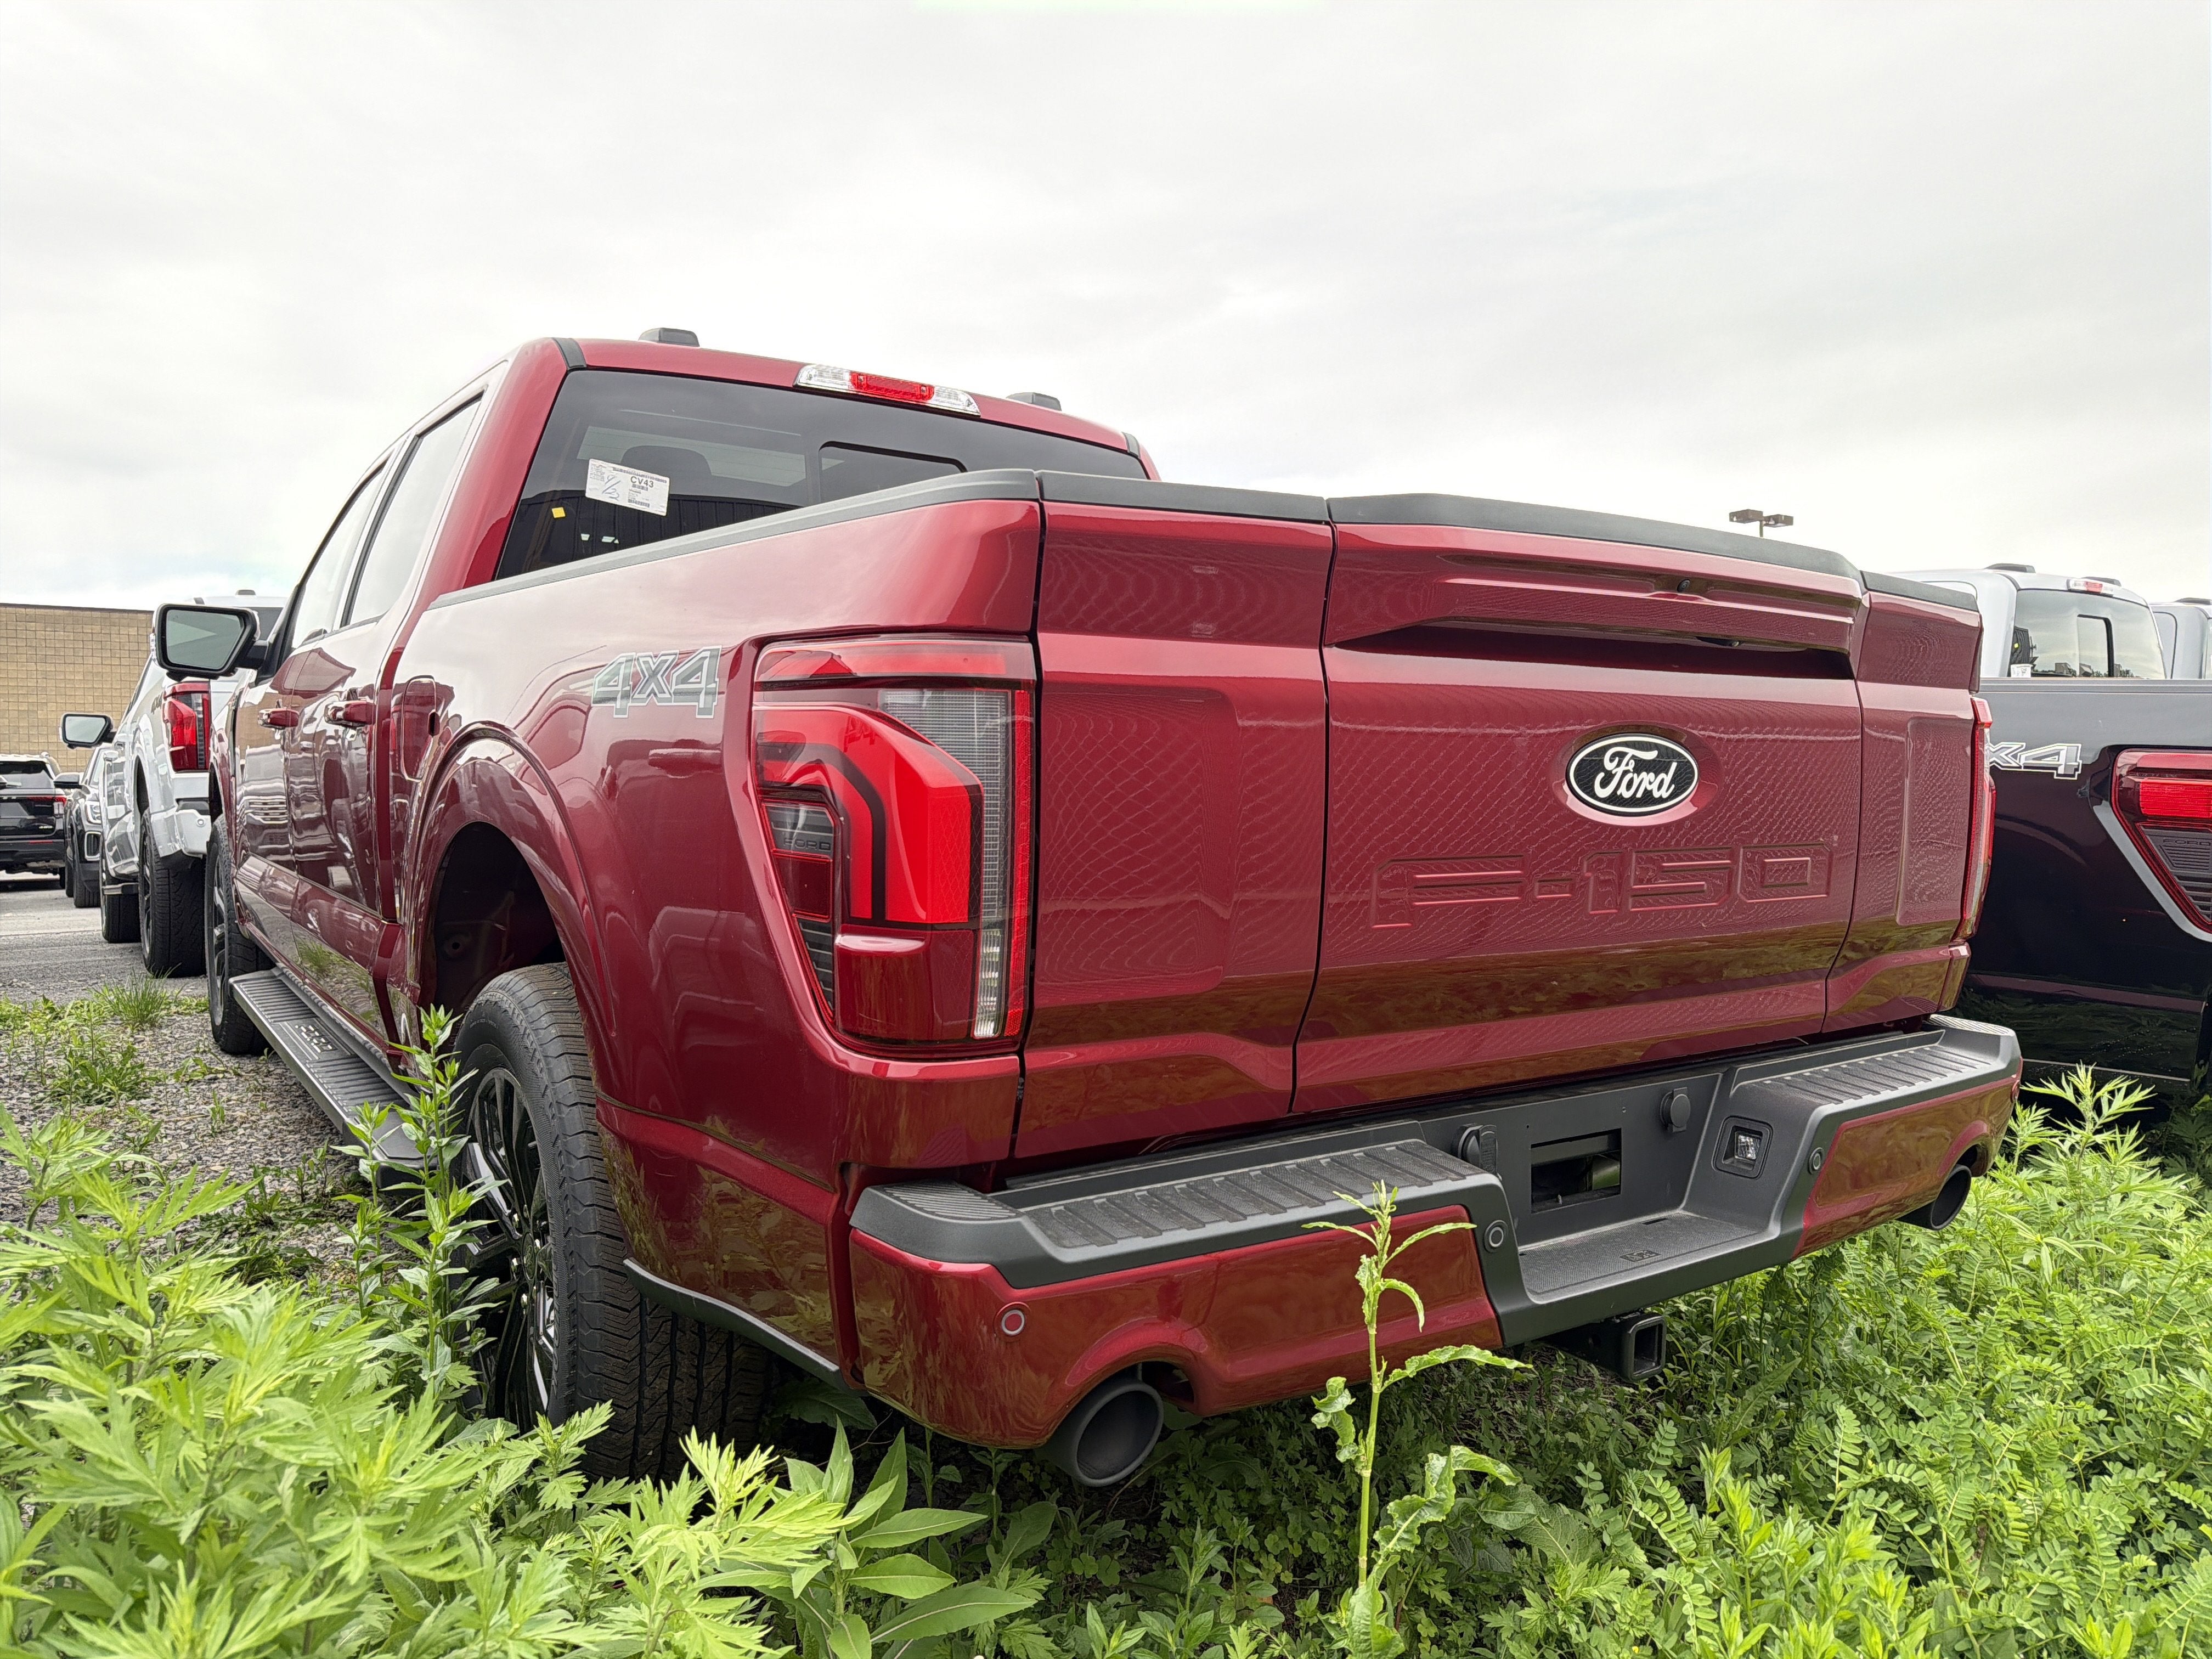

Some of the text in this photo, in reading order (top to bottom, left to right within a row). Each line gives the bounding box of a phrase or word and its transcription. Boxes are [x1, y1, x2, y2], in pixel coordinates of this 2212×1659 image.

[631, 476, 654, 488] CV43
[1594, 747, 1678, 798] Ford
[1989, 742, 2082, 780] X4
[783, 838, 831, 851] FORD
[1370, 843, 1833, 929] F-150
